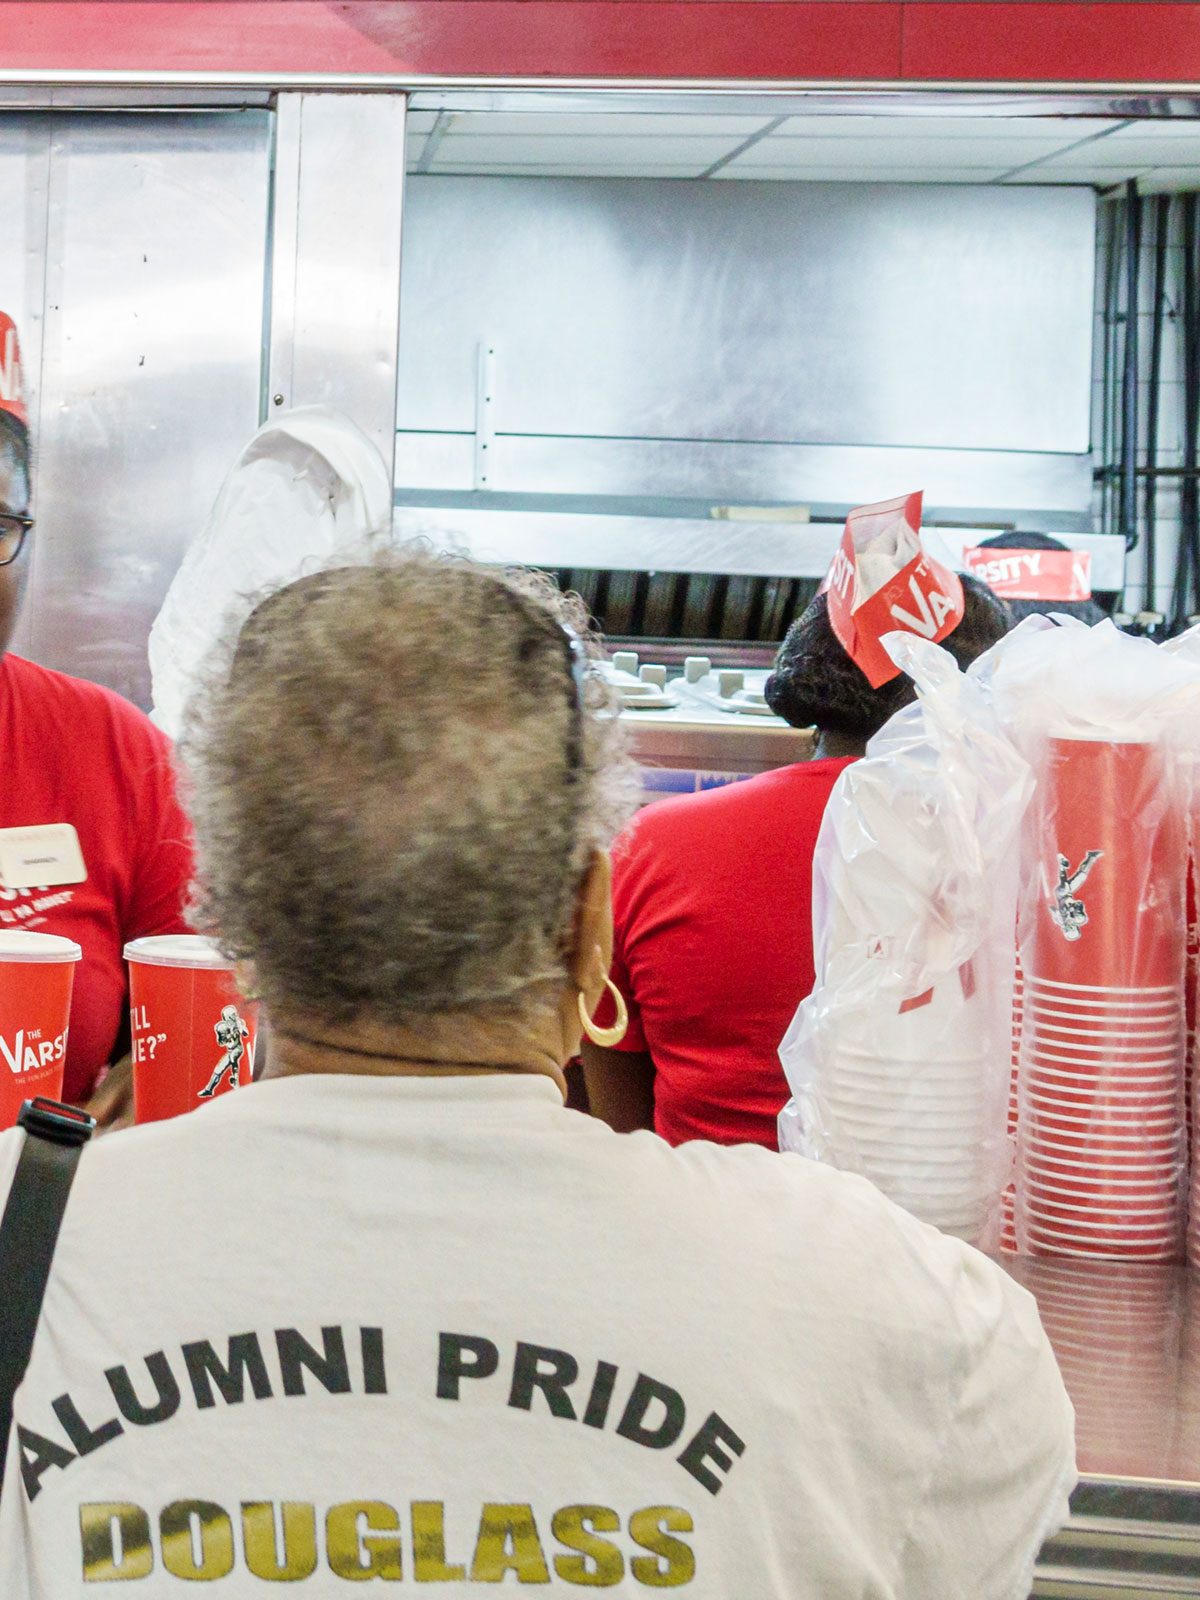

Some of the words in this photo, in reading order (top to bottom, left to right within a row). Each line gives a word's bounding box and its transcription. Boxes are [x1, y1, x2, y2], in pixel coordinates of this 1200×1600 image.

[26, 1028, 42, 1041] THE
[17, 1325, 388, 1503] ALUMNI
[435, 1331, 746, 1497] PRIDE
[78, 1499, 697, 1588] DOUGLASS
